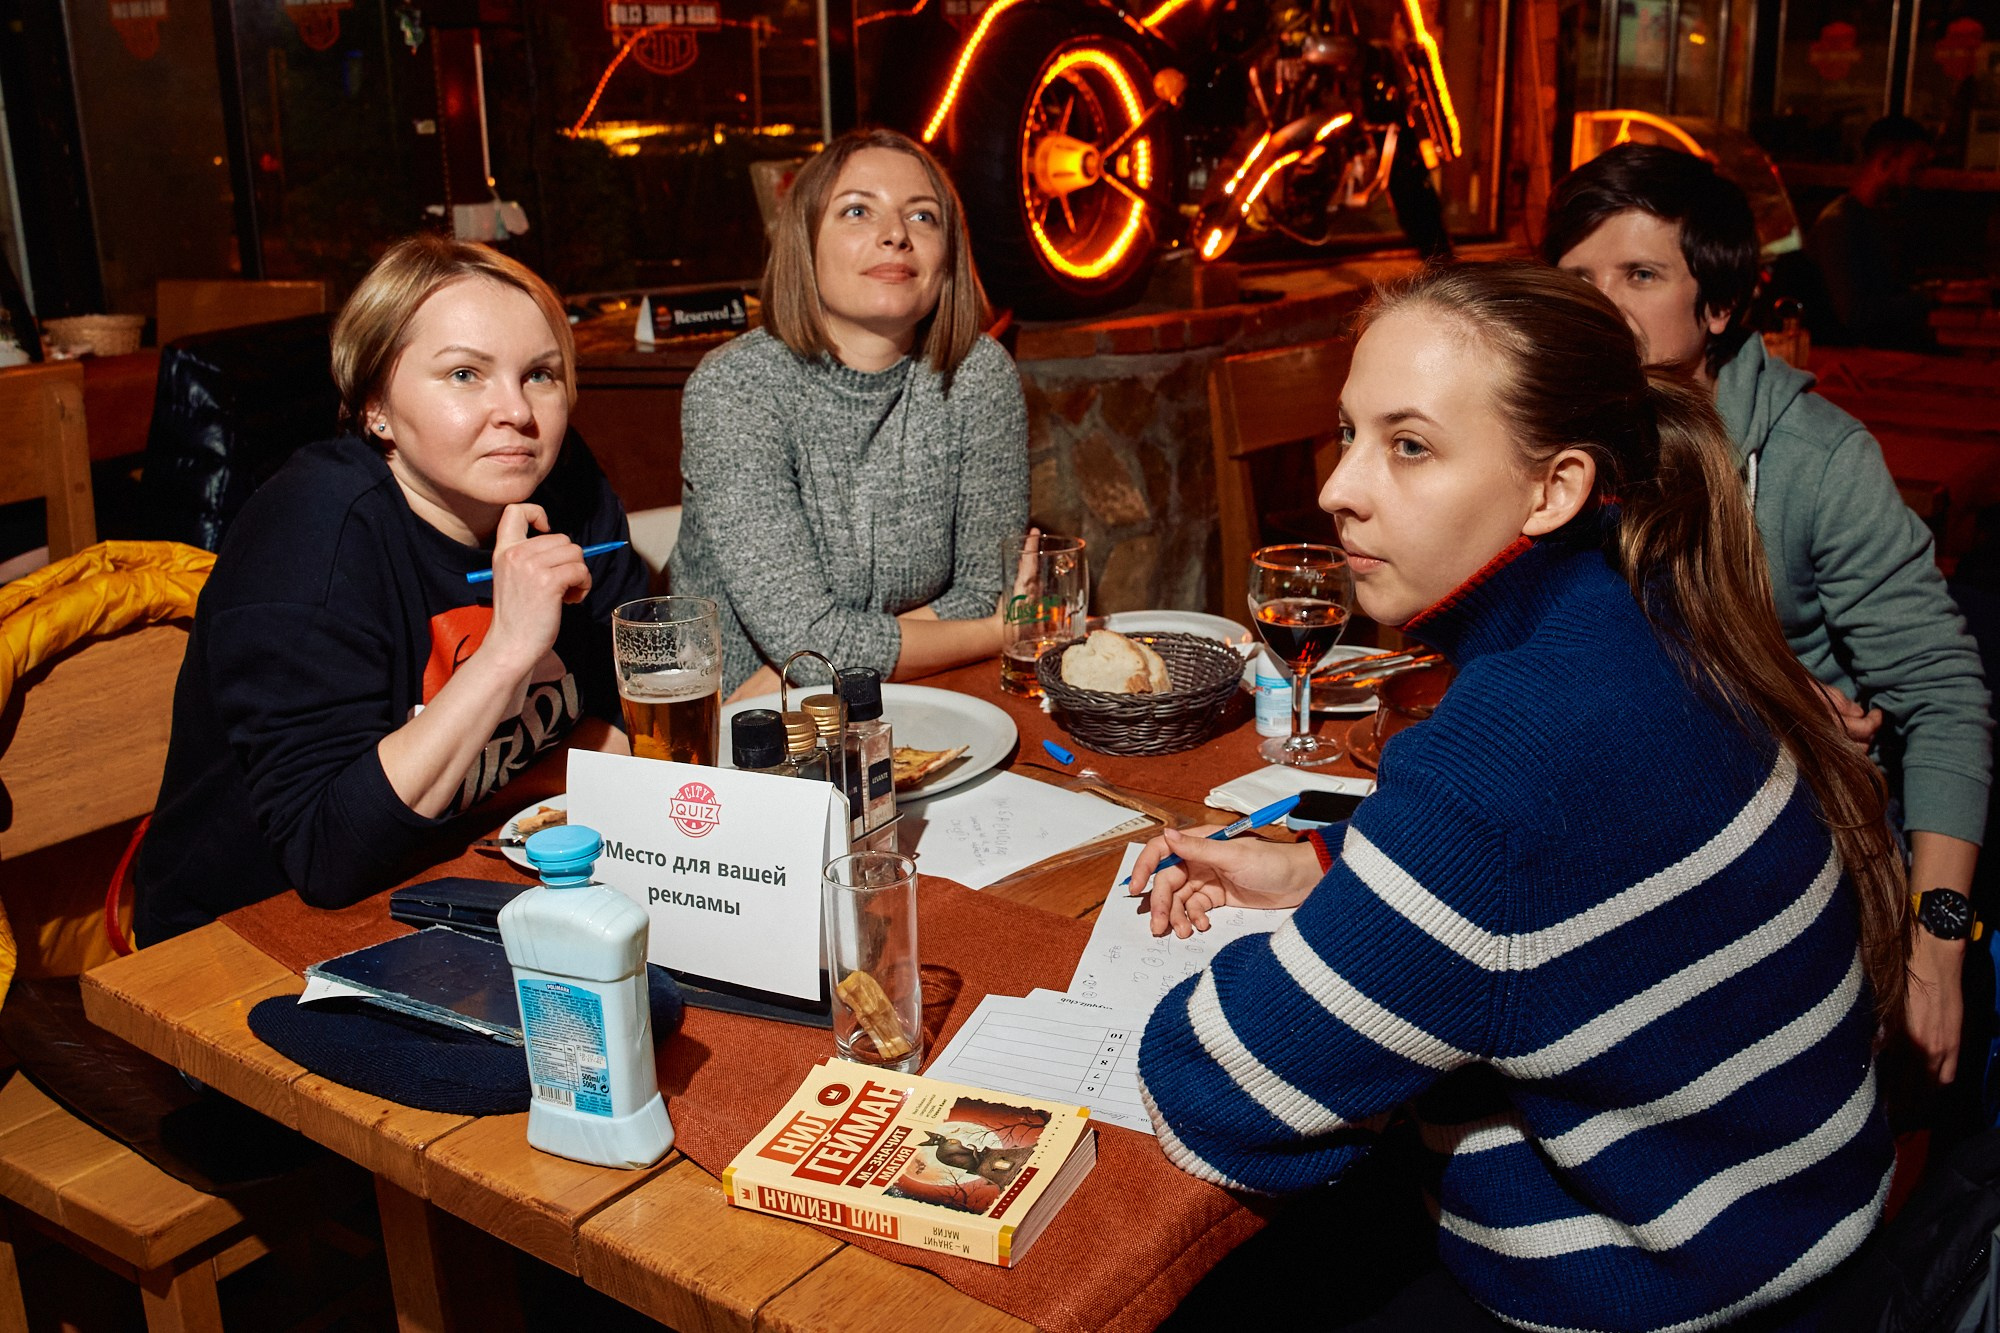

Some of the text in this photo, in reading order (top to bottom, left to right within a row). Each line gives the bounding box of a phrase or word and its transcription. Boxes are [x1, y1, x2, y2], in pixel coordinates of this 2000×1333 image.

[674, 305, 729, 325] Reserved
[684, 785, 710, 800] CITY
[676, 803, 714, 820] QUIZ
[605, 839, 787, 887] Место для вашей
[648, 885, 740, 916] рекламы
[583, 1080, 597, 1091] 500g
[772, 1117, 837, 1156] НИЛ
[810, 1087, 904, 1176] ГЕЙМАН
[880, 1147, 912, 1181] МАГИЯ
[764, 1191, 893, 1236] НИЛ ГЕЙМАН
[923, 1236, 954, 1250] ЗНАЧИТ
[933, 1226, 960, 1240] МАГИЯ
